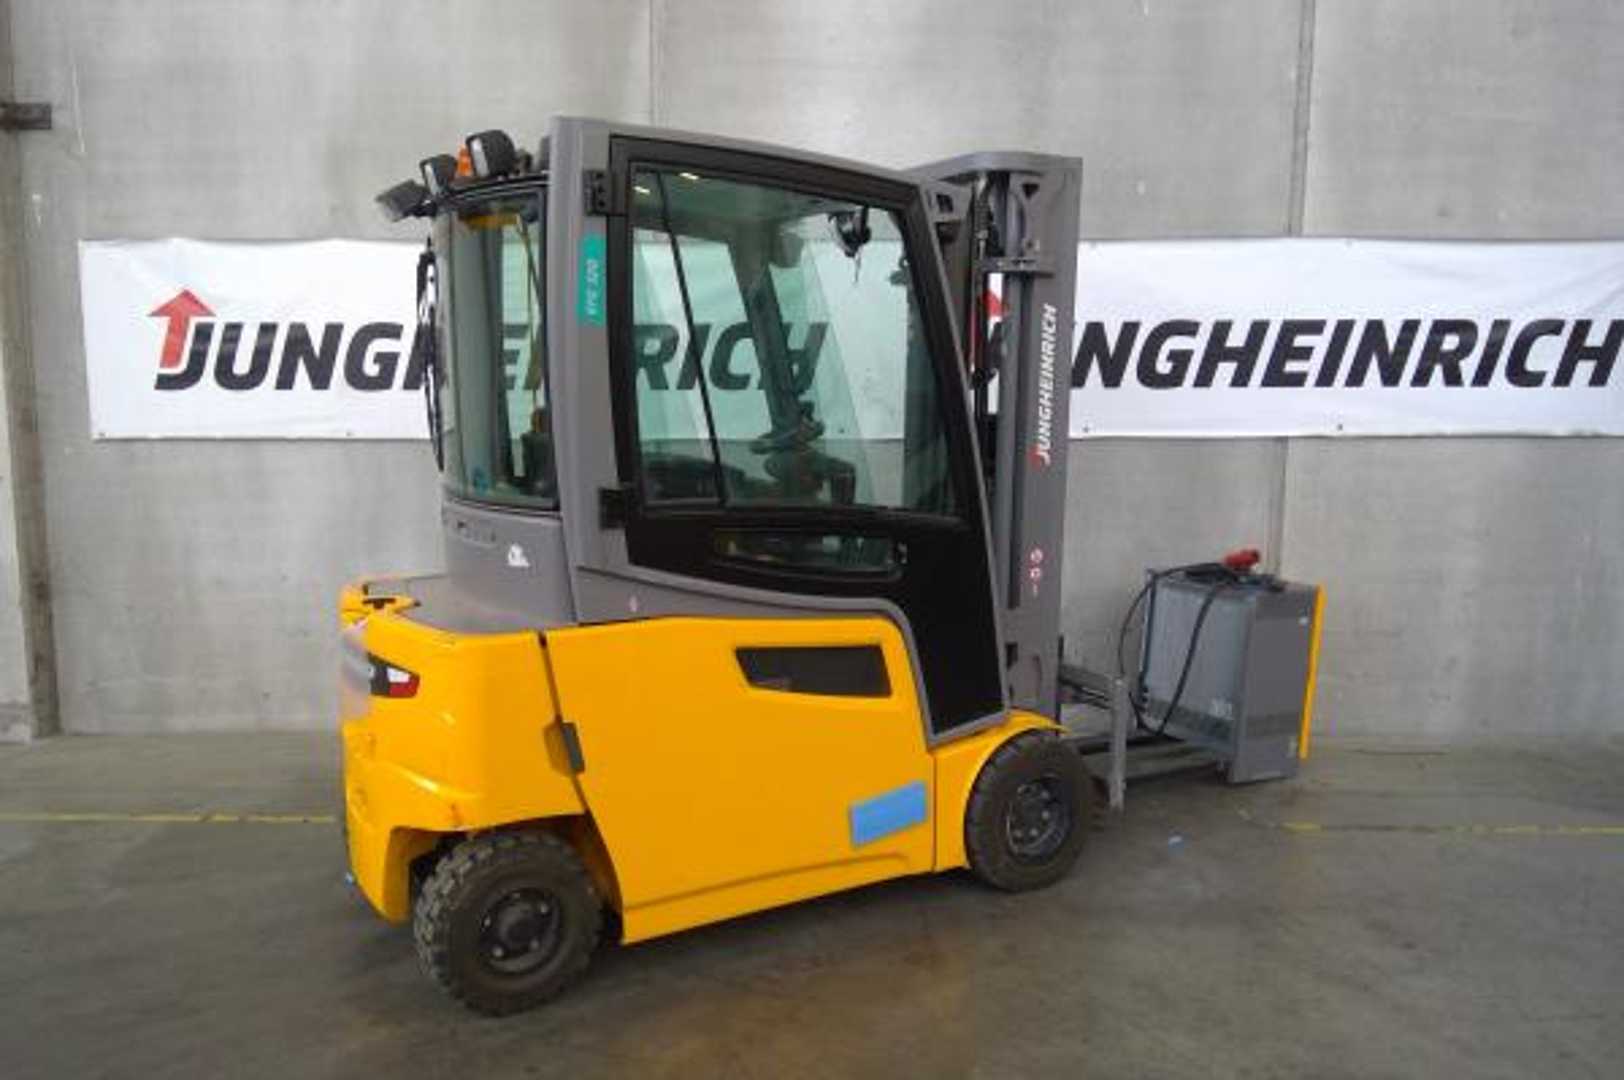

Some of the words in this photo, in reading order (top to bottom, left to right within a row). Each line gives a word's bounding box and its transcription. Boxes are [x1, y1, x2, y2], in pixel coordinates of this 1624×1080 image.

[154, 321, 829, 390] JUNGERICH
[984, 318, 1624, 389] NGHEINRICH
[1036, 302, 1058, 465] JUNGHEINRICH
